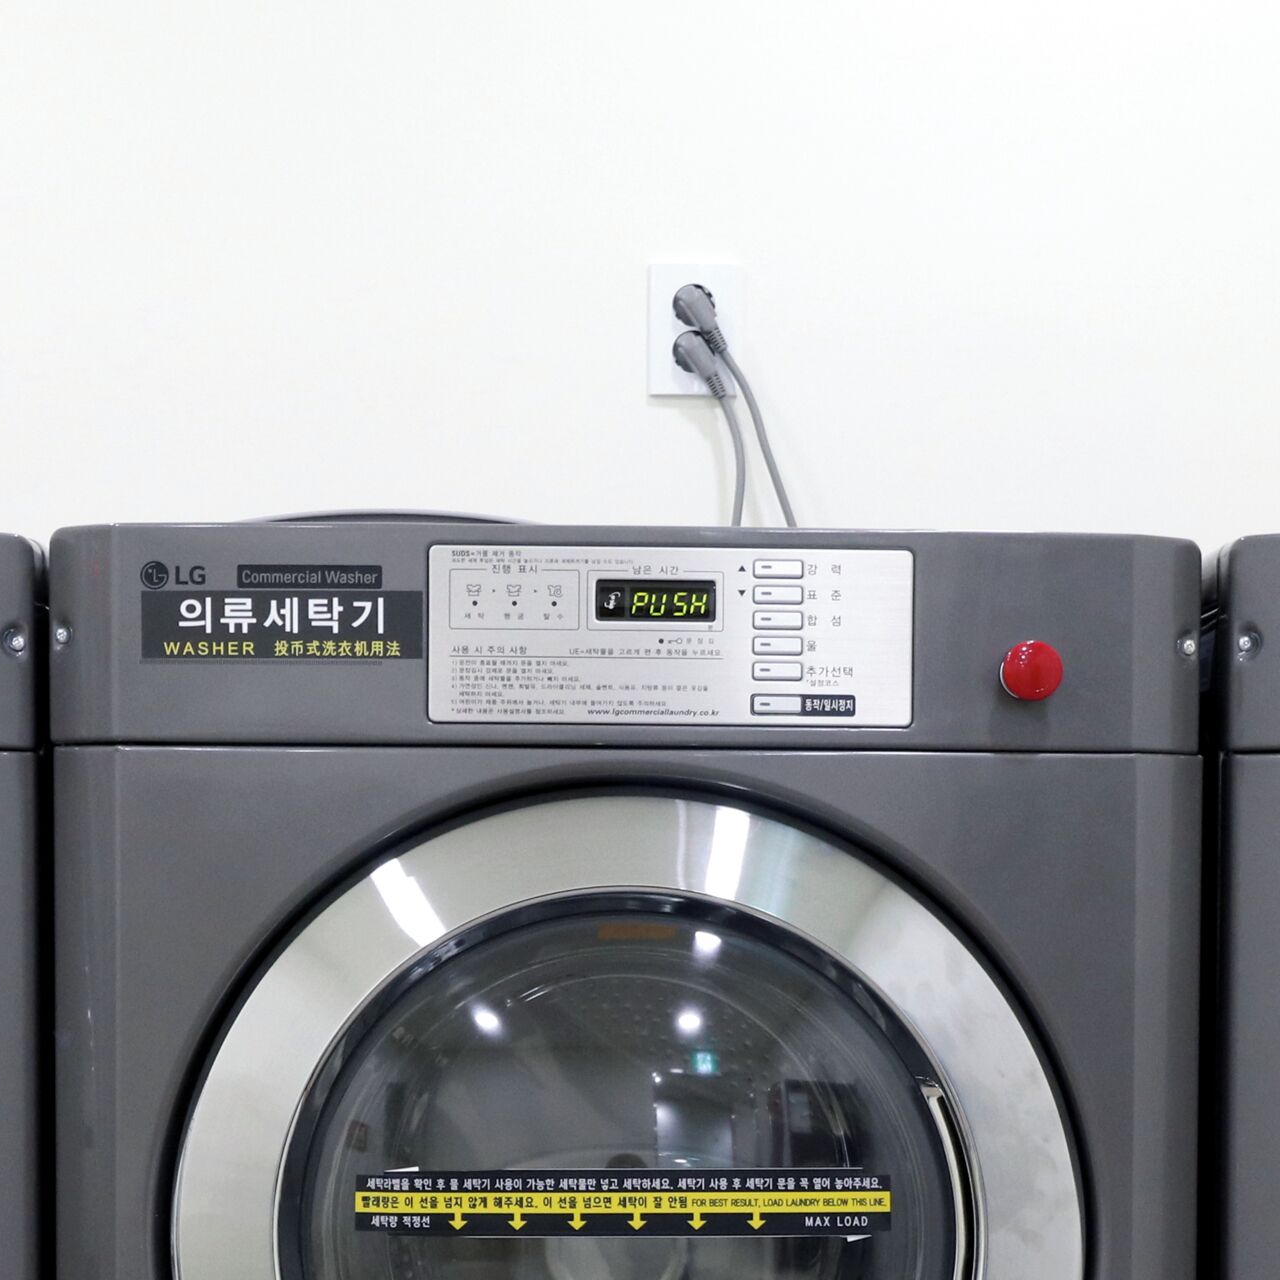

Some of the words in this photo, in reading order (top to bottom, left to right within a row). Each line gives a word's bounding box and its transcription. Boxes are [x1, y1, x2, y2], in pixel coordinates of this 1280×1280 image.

[176, 566, 206, 585] LG
[492, 564, 511, 574] 진행
[518, 565, 538, 574] 표시
[632, 566, 652, 576] 남은
[658, 566, 679, 576] 시간
[242, 569, 321, 584] Commercial
[325, 570, 377, 584] Washer
[631, 591, 707, 616] PUSH
[178, 596, 385, 634] 의류세탁기
[164, 641, 255, 655] WASHER
[274, 640, 401, 657] 投币式洗衣机用法
[452, 646, 470, 654] 사용
[475, 646, 483, 654] 시
[806, 666, 854, 678] 추가선택
[804, 698, 854, 711] 동작/일시정지
[366, 1178, 409, 1190] 세탁라벨을
[414, 1178, 431, 1190] 확인
[436, 1178, 445, 1190] 후
[449, 1178, 458, 1190] 물
[463, 1178, 490, 1190] 세탁기
[494, 1178, 521, 1190] 사용이
[526, 1178, 554, 1190] 가능한
[558, 1178, 596, 1190] 세탁물만
[622, 1178, 673, 1189] 세탁하세요.
[677, 1178, 704, 1189] 세탁기
[709, 1177, 727, 1190] 사용
[732, 1177, 741, 1189] 후
[745, 1177, 772, 1189] 세탁기
[777, 1177, 795, 1189] 문을
[799, 1177, 808, 1189] 꼭
[812, 1177, 830, 1189] 열어
[834, 1177, 882, 1189] 놓아주세요.
[404, 1196, 413, 1208] 이
[419, 1196, 438, 1208] 선을
[468, 1196, 487, 1208] 않게
[493, 1196, 537, 1208] 해주세요.
[543, 1196, 551, 1208] 이
[558, 1196, 577, 1208] 선을
[617, 1196, 646, 1208] 세탁이
[653, 1196, 662, 1208] 잘
[370, 1215, 397, 1227] 세탁량
[402, 1215, 429, 1227] 적정선
[805, 1216, 830, 1226] MAX
[837, 1216, 867, 1226] LOAD
